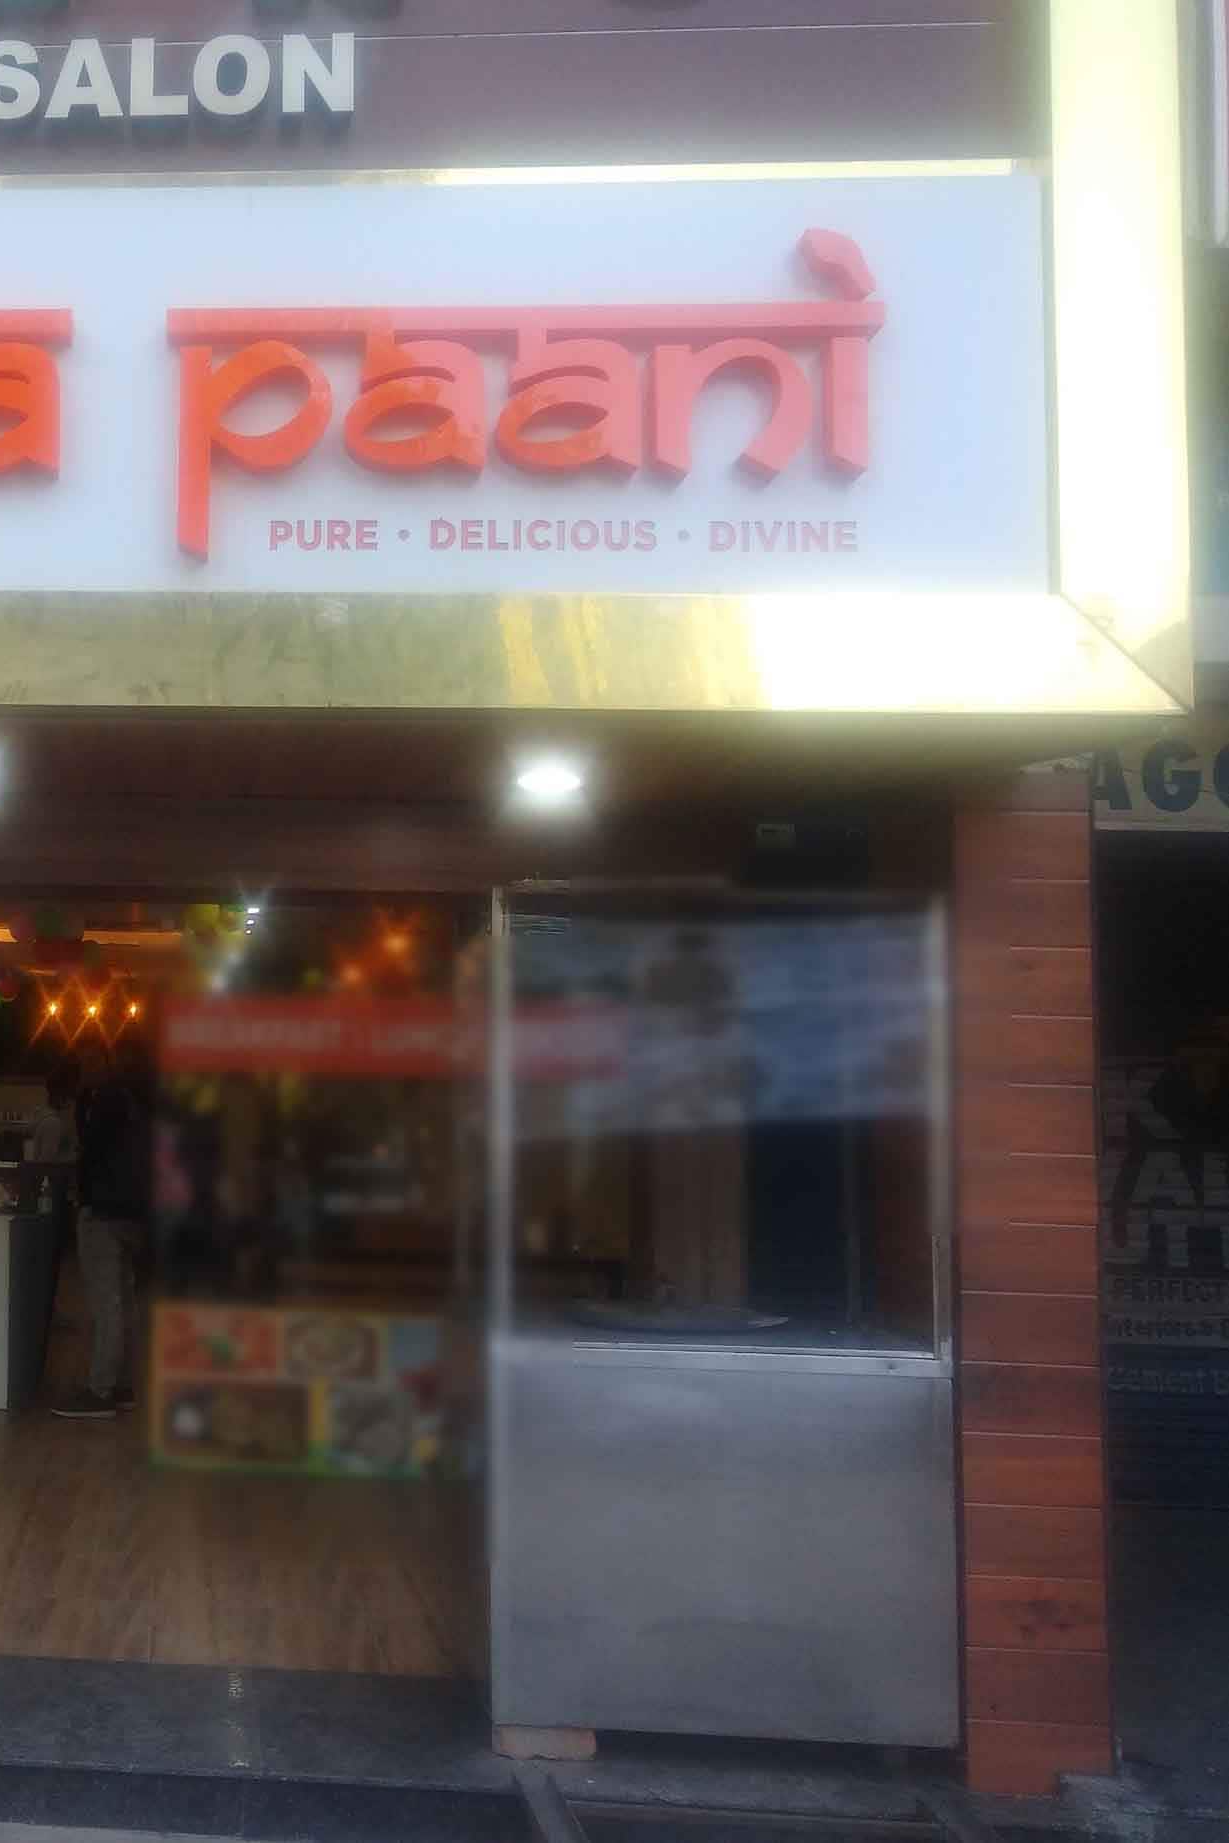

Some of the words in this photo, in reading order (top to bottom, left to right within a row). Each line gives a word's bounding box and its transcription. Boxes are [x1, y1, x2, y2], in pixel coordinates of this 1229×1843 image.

[166, 228, 887, 563] paani
[268, 519, 379, 552] PURE
[429, 517, 658, 553] DELICIOUS
[708, 519, 859, 554] DIVINE
